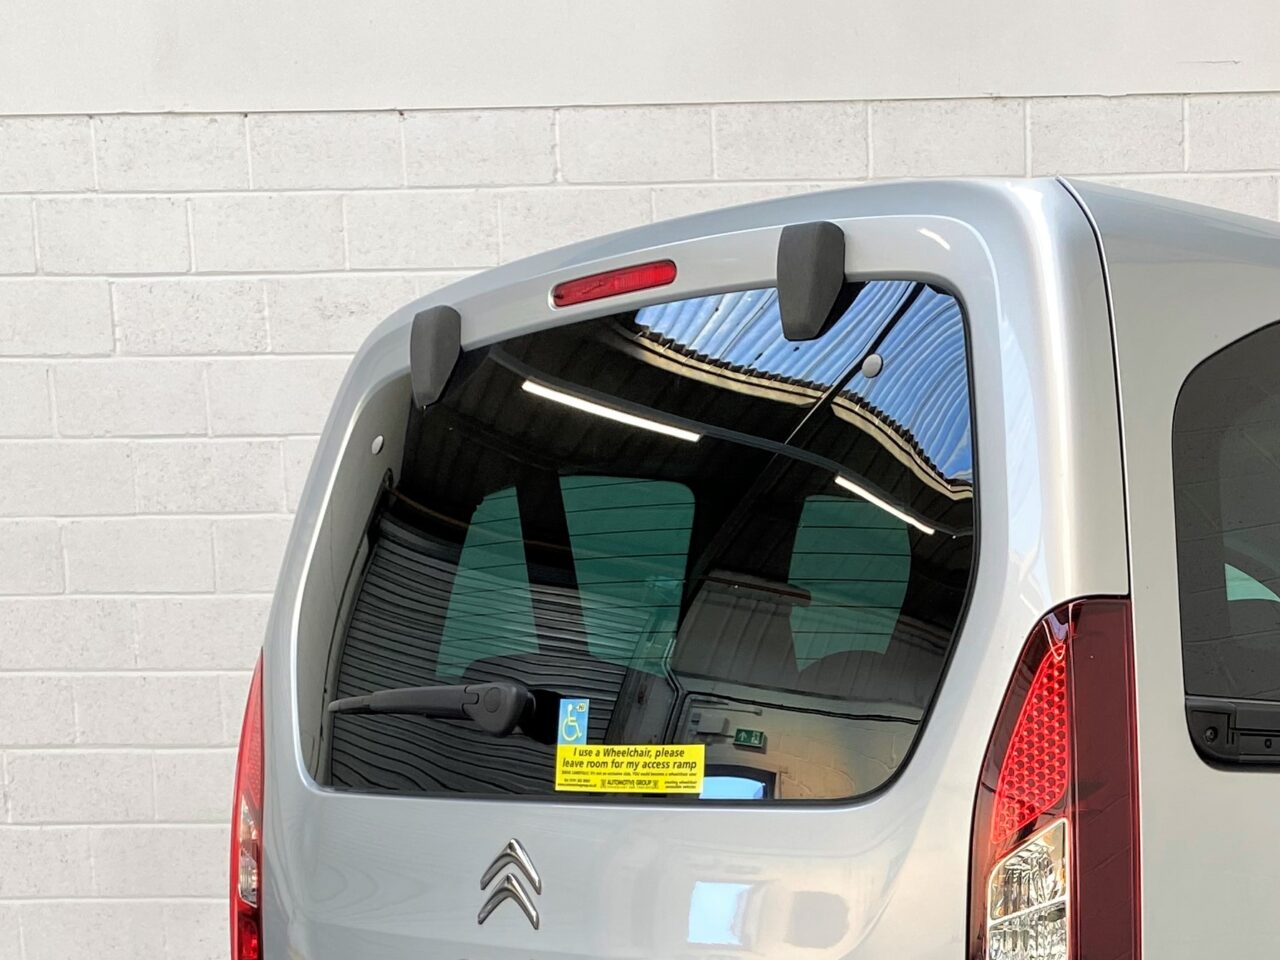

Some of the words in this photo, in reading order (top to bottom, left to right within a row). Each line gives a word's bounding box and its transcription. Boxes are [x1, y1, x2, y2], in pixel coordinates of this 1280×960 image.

[573, 747, 577, 756] I
[579, 749, 593, 757] use
[595, 749, 600, 757] a
[603, 747, 652, 759] Wheelchair,
[654, 747, 685, 760] please
[562, 758, 585, 768] leave
[586, 760, 609, 768] room
[611, 759, 624, 768] for
[626, 761, 640, 771] my
[642, 761, 670, 769] access
[672, 761, 697, 772] ramp
